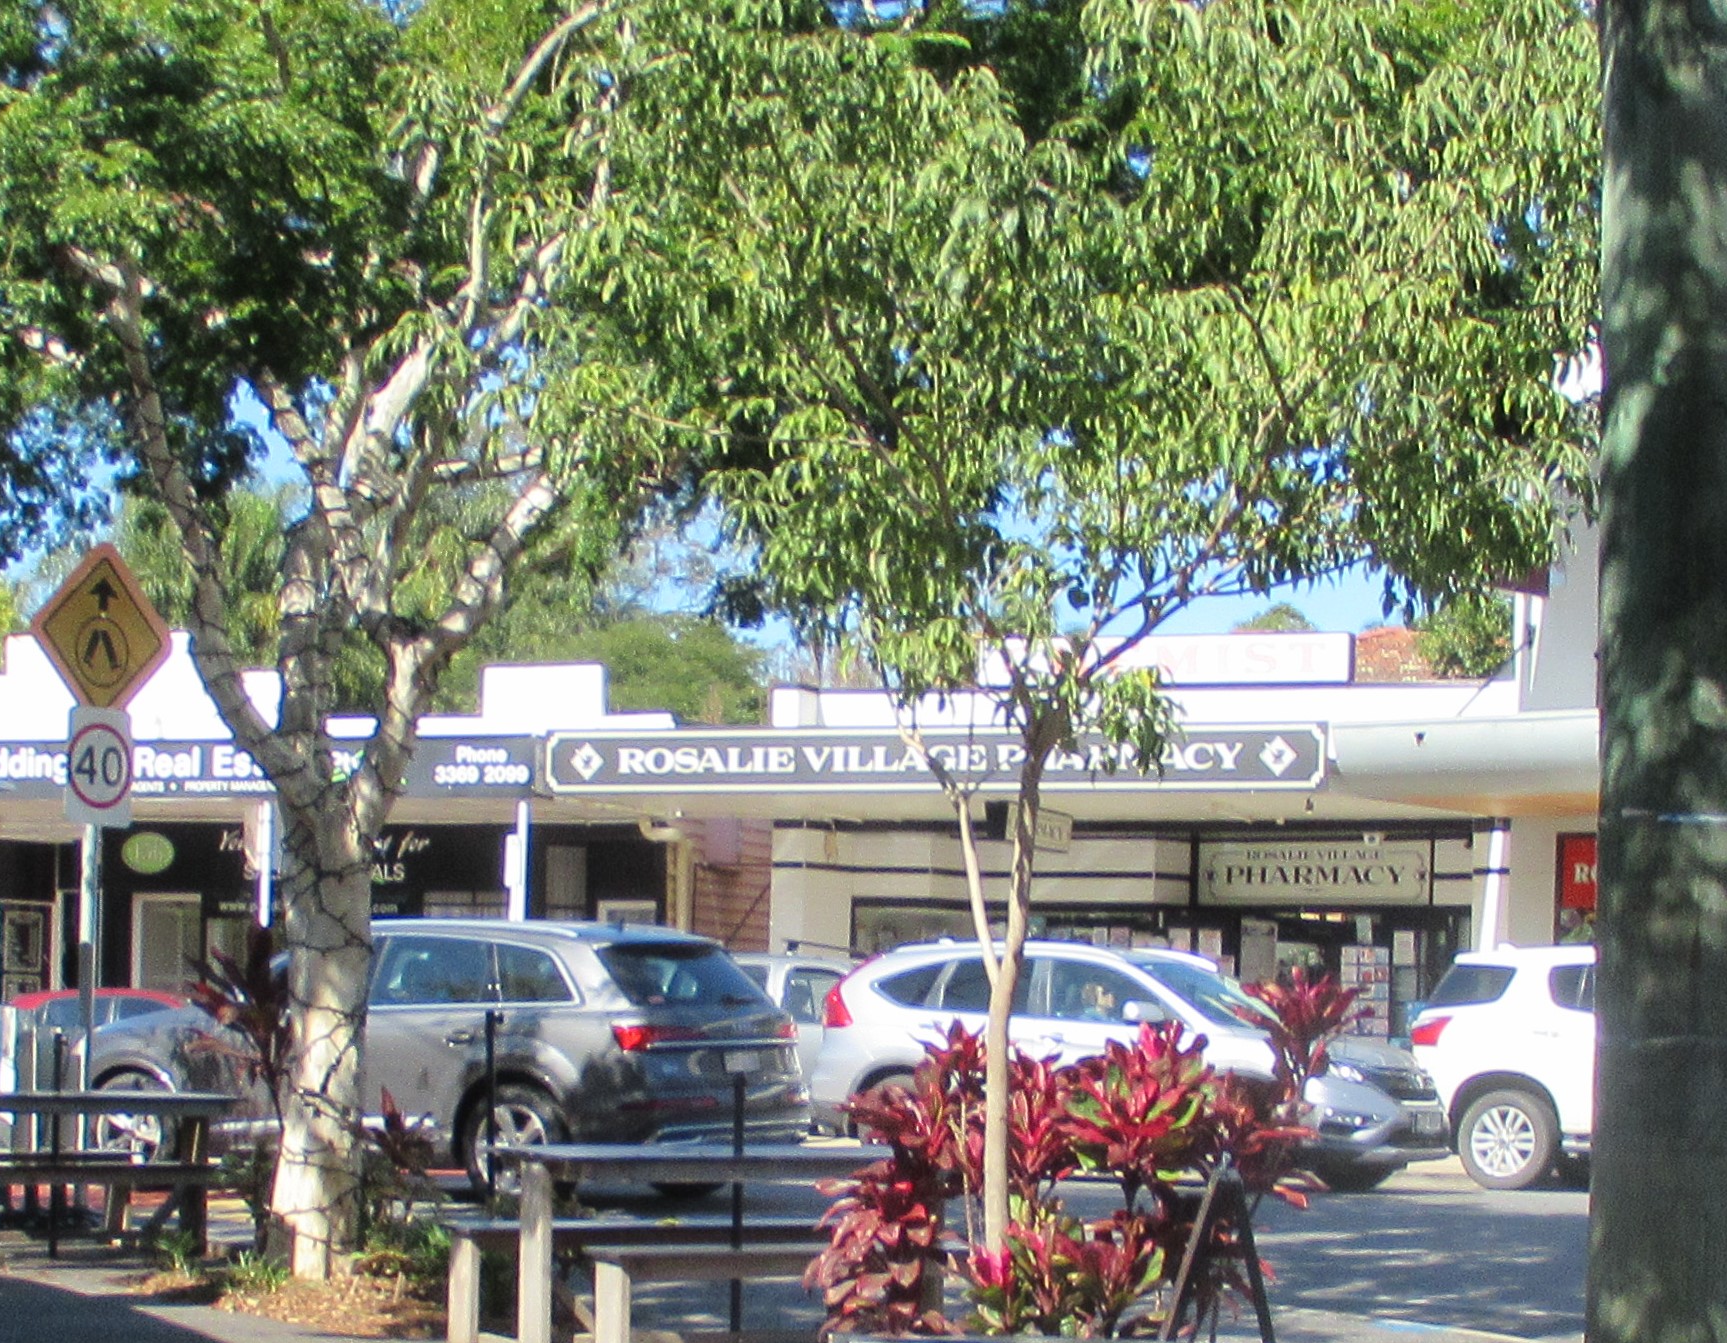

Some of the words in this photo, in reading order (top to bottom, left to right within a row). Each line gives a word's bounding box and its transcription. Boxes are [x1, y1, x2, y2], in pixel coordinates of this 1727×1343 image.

[74, 745, 123, 787] 40
[133, 745, 201, 778] Real
[455, 745, 508, 763] Phone
[617, 746, 795, 774] ROSALIE
[801, 745, 989, 773] VILLAGE
[434, 765, 479, 784] 3369
[484, 765, 530, 784] 2099
[1225, 864, 1405, 885] PHARMACY
